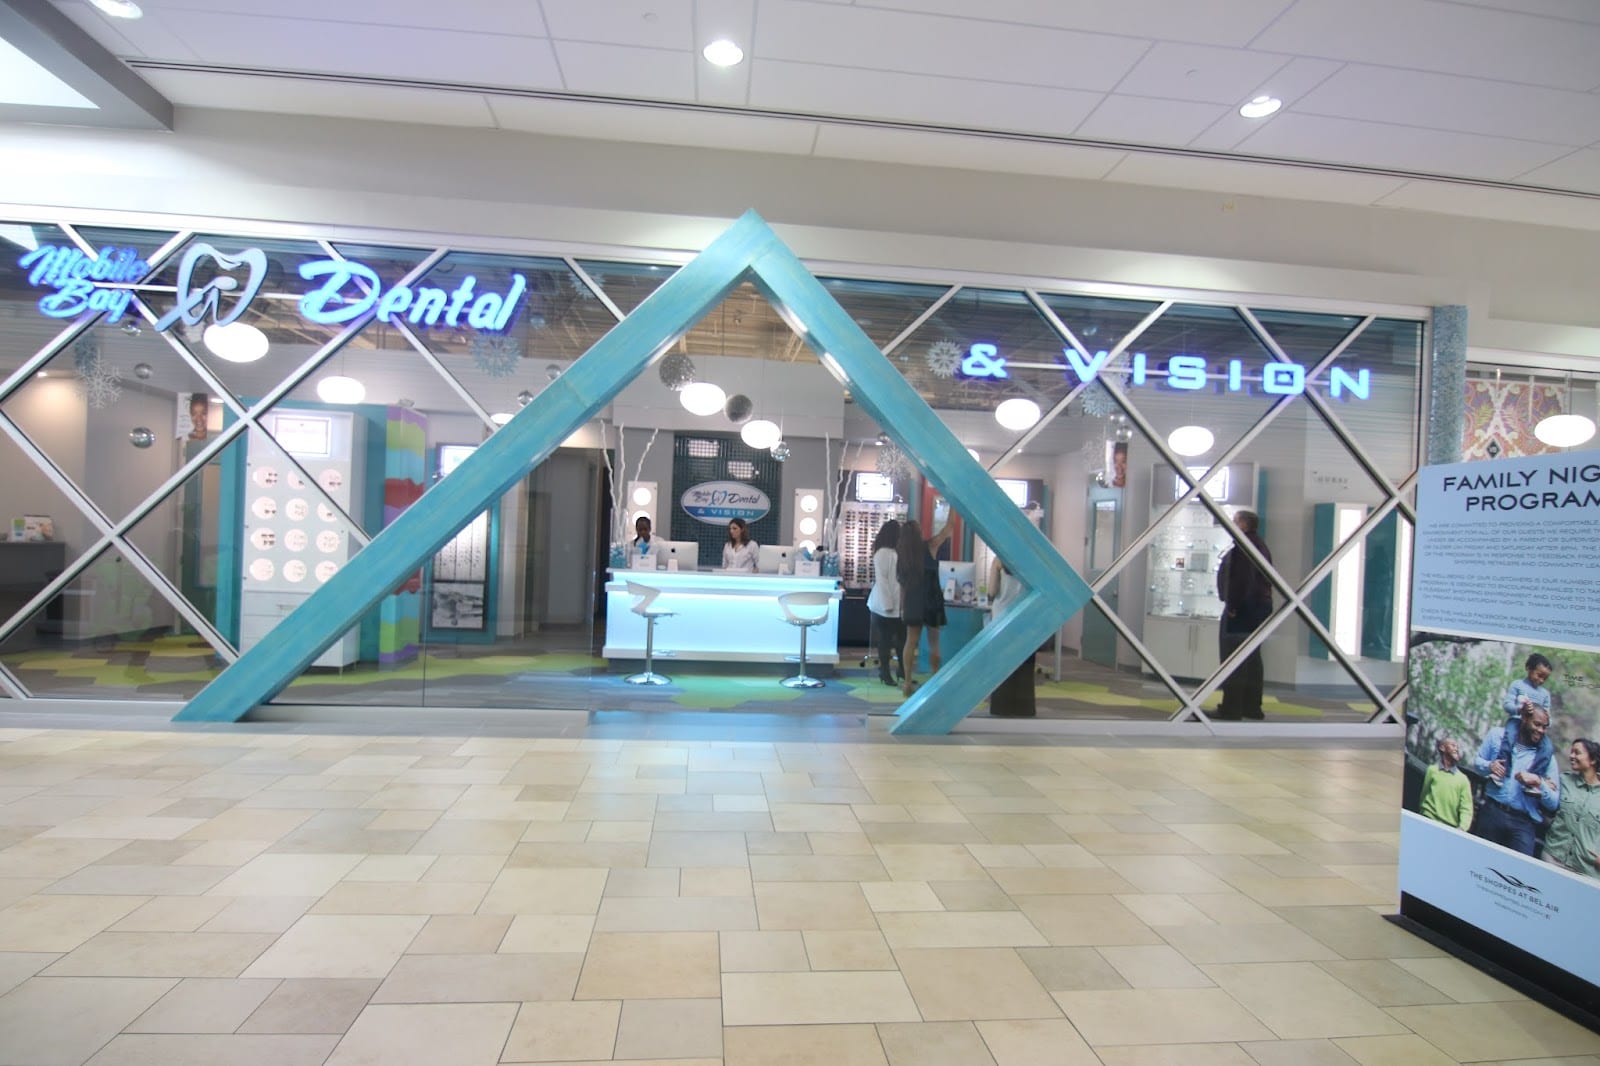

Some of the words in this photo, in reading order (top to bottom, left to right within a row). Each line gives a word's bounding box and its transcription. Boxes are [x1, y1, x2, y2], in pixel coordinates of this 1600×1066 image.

[18, 245, 149, 287] Mobile
[39, 279, 133, 323] Bay
[298, 260, 526, 331] Dental
[961, 343, 1007, 378] &
[1064, 349, 1371, 400] VISION
[728, 493, 760, 504] Dental
[1443, 470, 1537, 492] FAMILY
[1469, 870, 1483, 881] THE
[1518, 891, 1528, 900] AT
[1529, 895, 1544, 907] BEL
[1545, 902, 1559, 913] AIR
